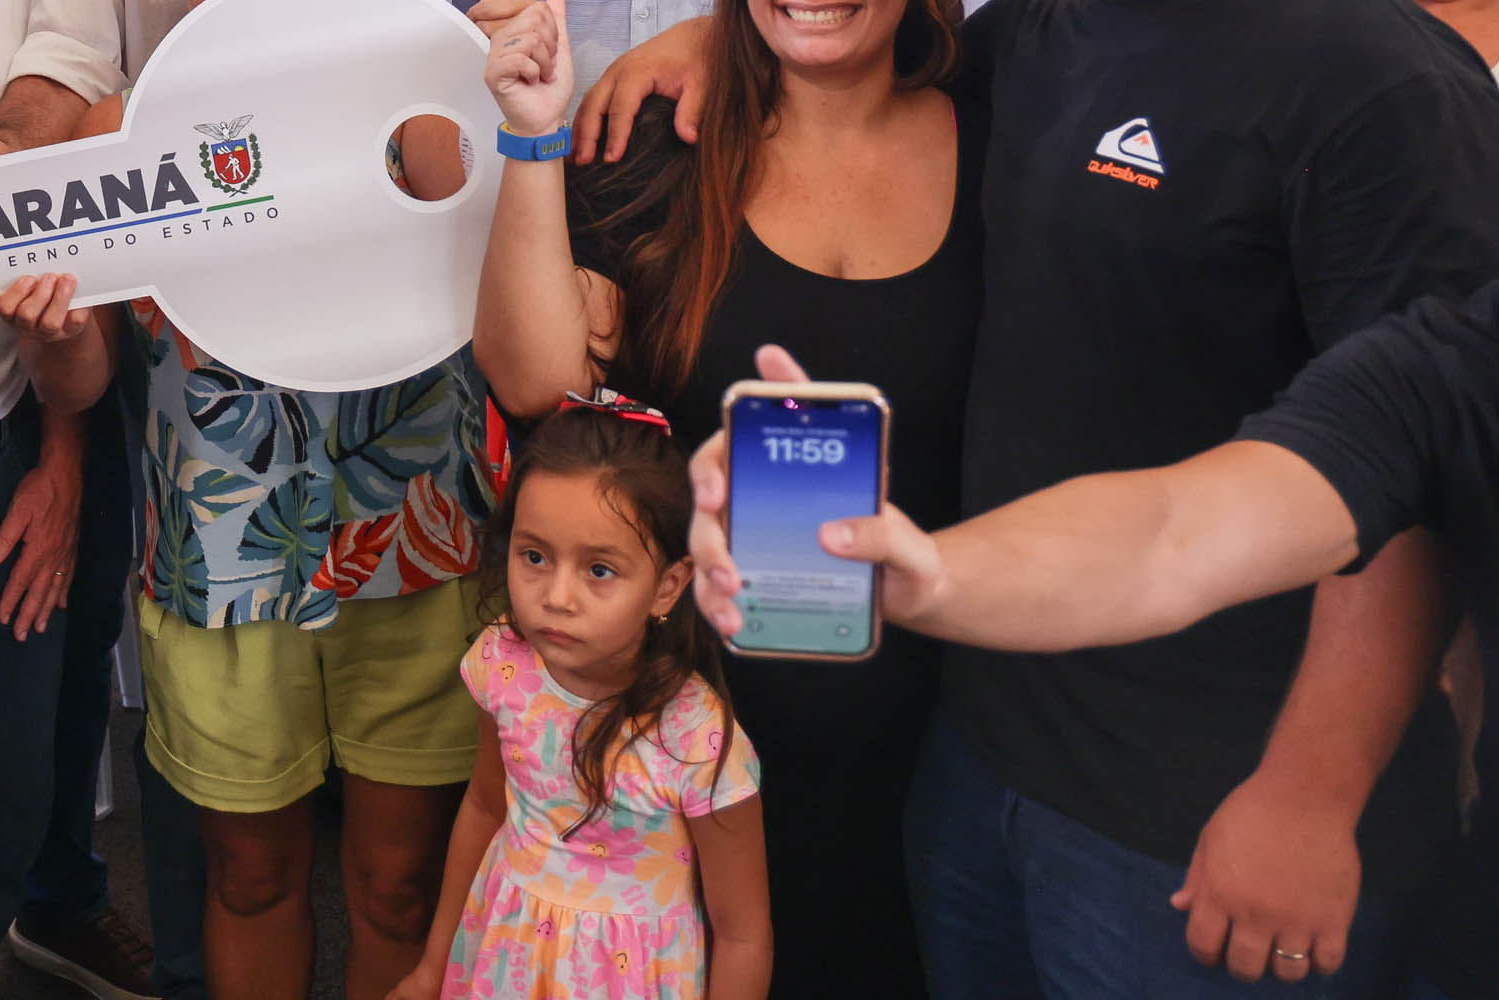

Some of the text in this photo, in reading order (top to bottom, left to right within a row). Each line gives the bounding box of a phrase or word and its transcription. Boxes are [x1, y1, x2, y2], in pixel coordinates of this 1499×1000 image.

[104, 233, 137, 250] DO
[162, 207, 279, 239] ESTADO
[763, 437, 845, 465] 11:59
